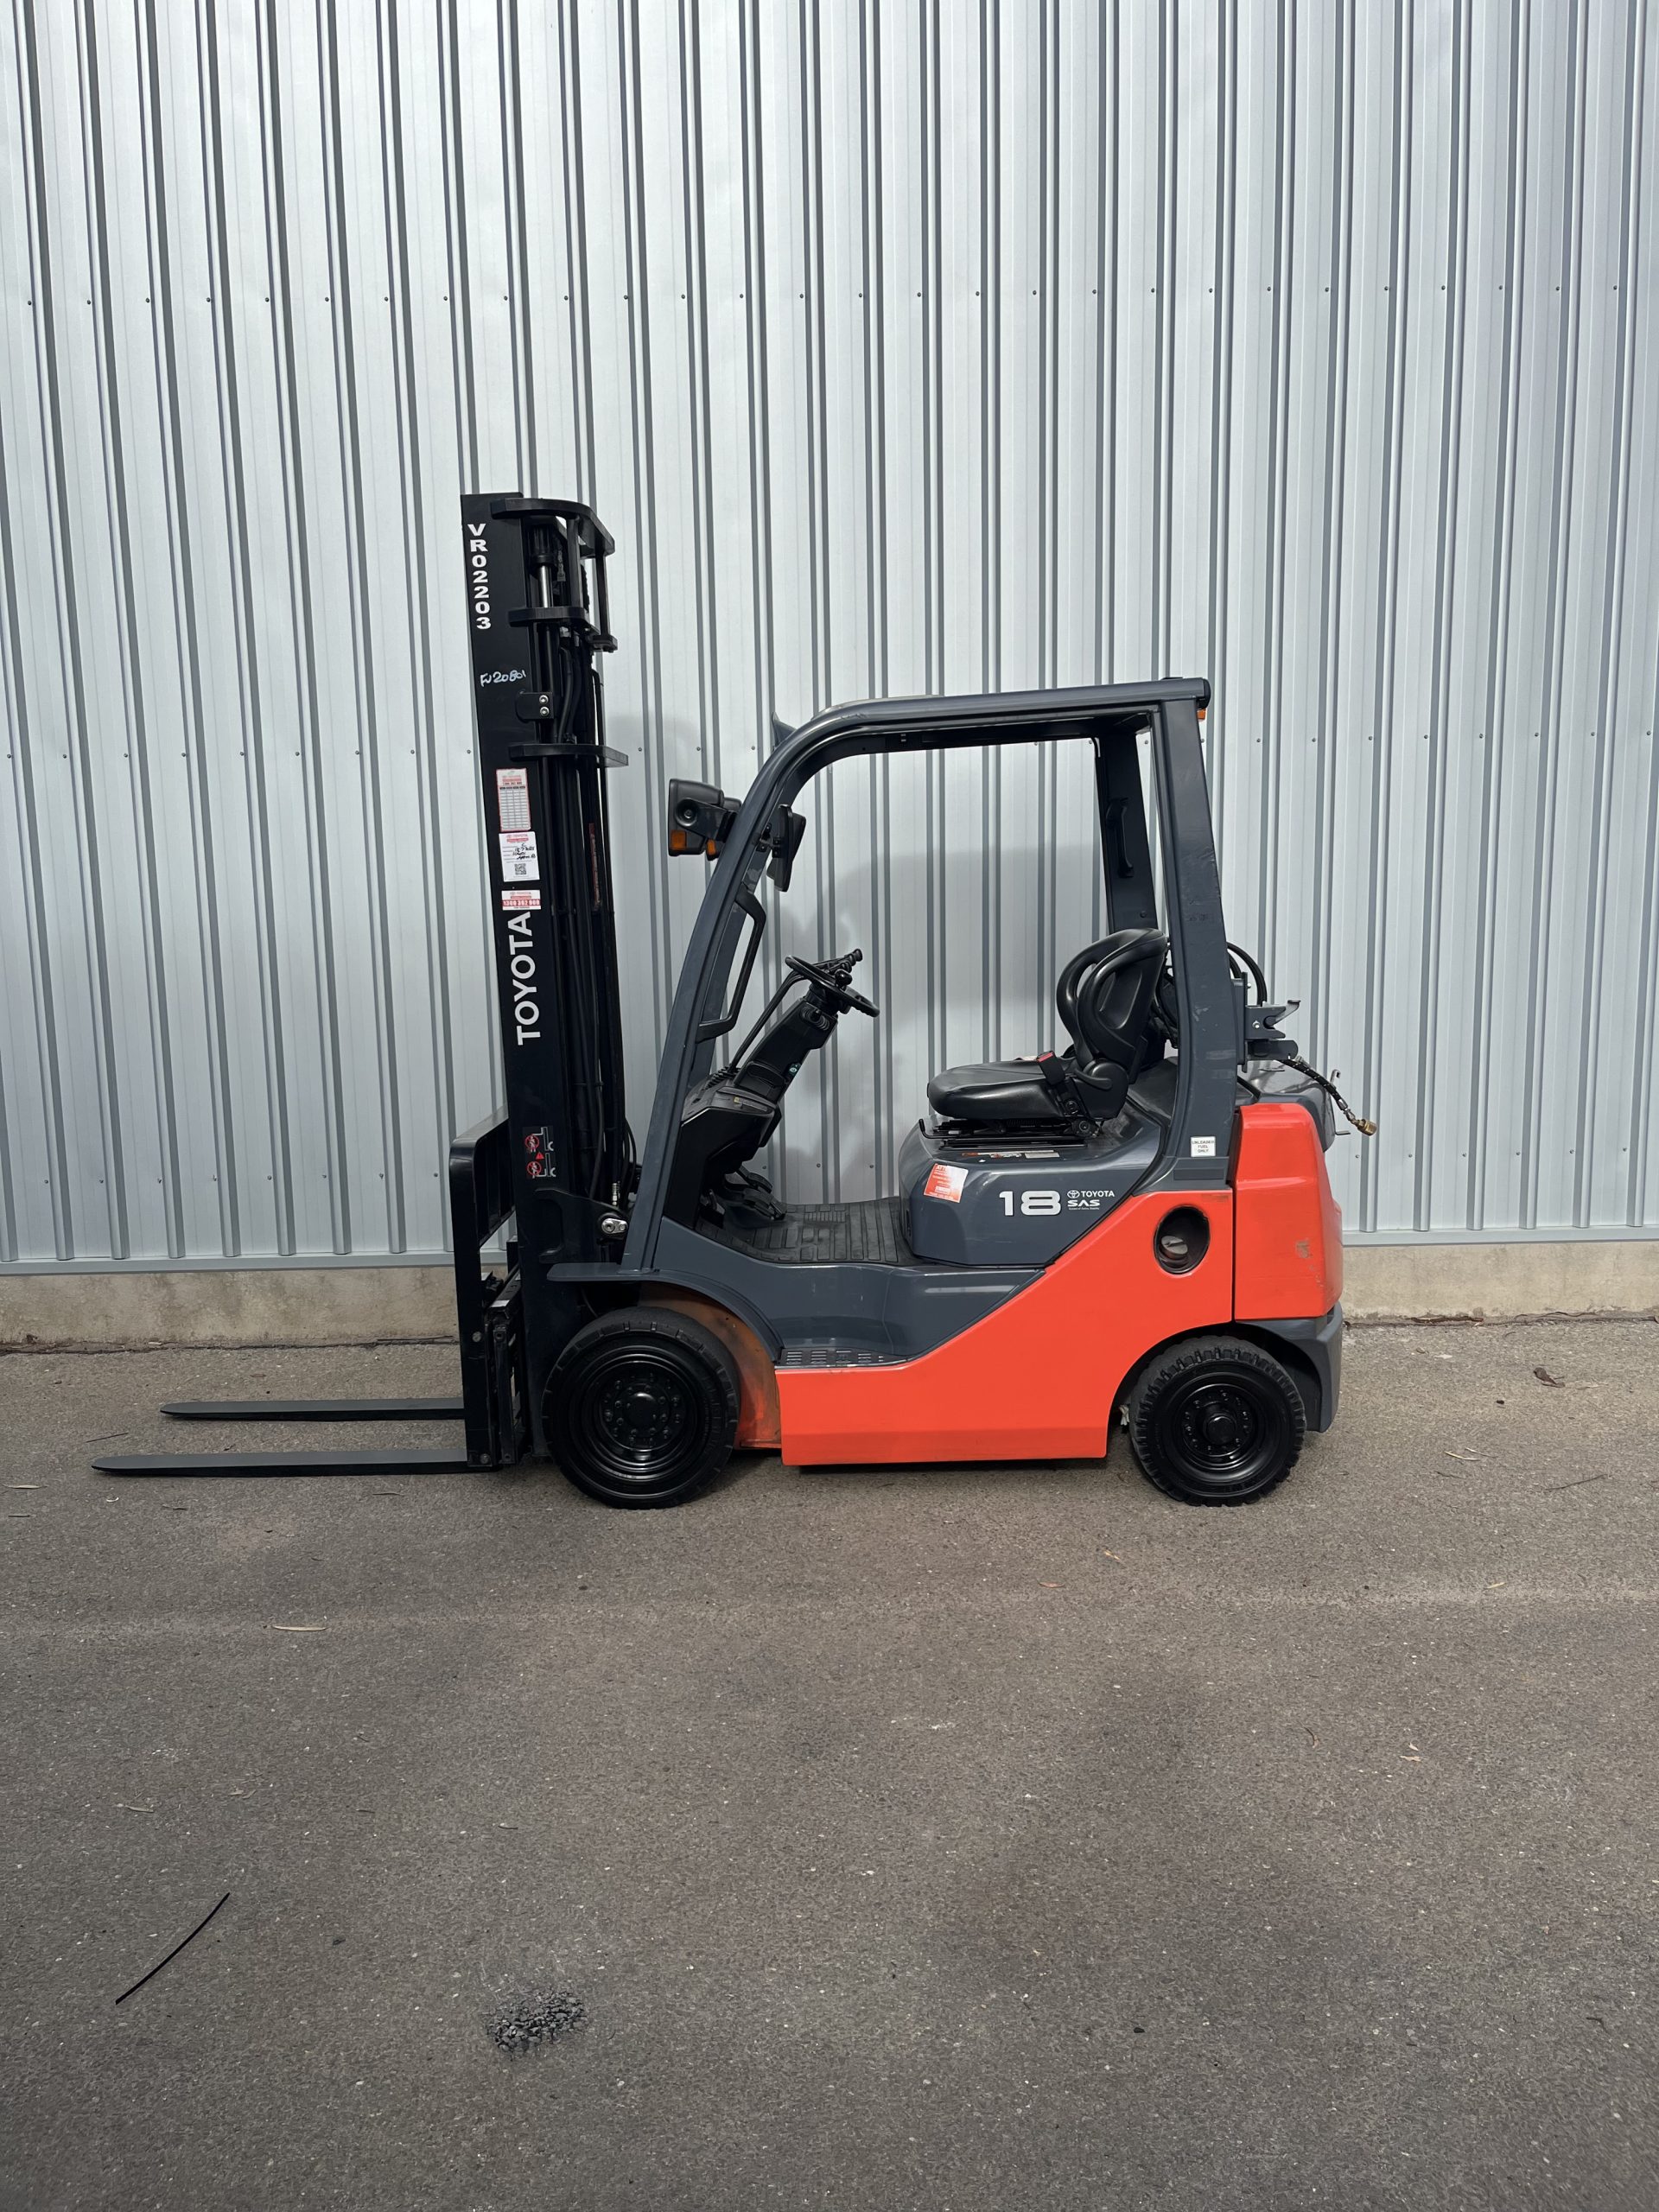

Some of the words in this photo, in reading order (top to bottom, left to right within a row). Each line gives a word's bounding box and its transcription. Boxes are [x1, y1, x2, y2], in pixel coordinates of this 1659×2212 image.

[467, 524, 491, 629] VR02203
[507, 912, 541, 1046] TOYOTA
[999, 1191, 1061, 1216] 18
